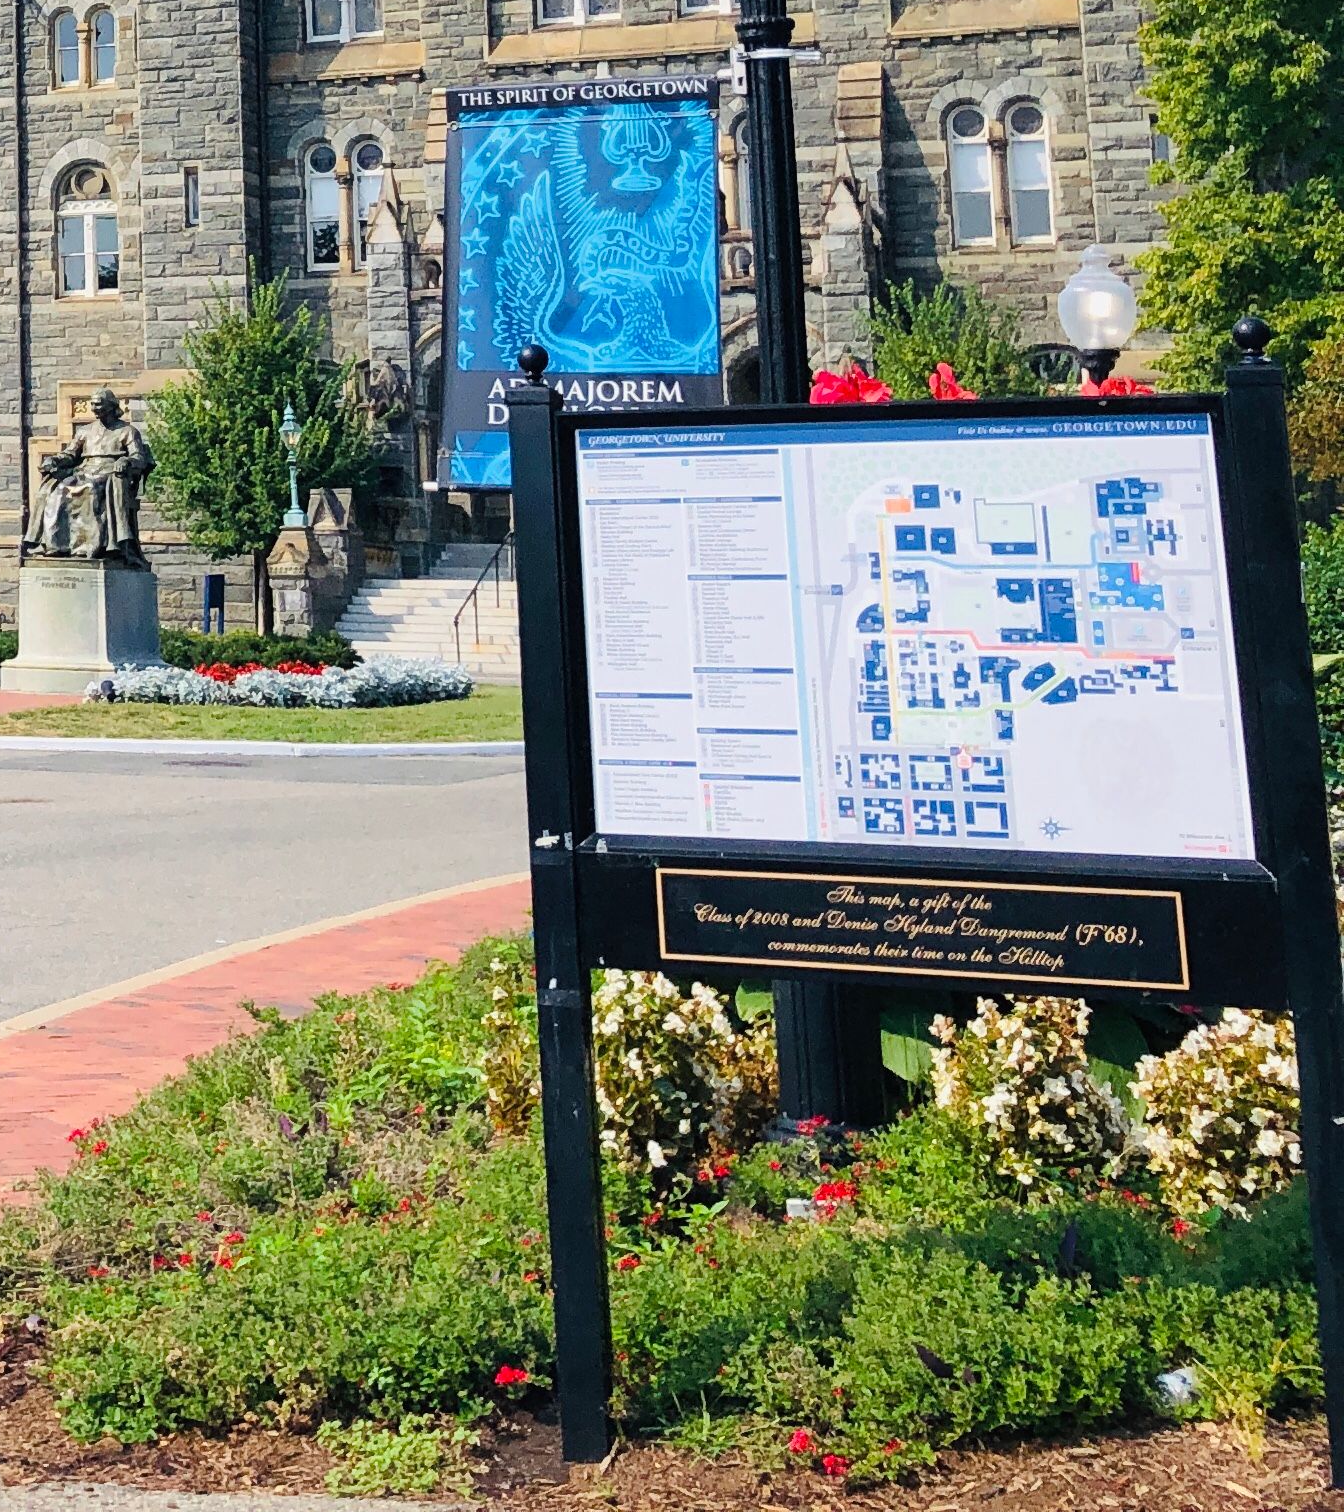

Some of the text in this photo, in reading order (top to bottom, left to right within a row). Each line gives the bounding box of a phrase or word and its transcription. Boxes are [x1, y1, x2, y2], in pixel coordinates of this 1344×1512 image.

[458, 79, 709, 107] THE SPIRIT OF GEORGETOWN
[588, 432, 726, 447] GEORGETOWN UNIVERSITY
[1052, 418, 1197, 433] GEORGETOWN.EDU
[826, 885, 992, 914] This map, a gift of the
[693, 903, 732, 923] Class
[735, 908, 753, 929] of
[752, 912, 788, 926] 2008
[792, 912, 824, 928] and
[825, 909, 878, 931] Denise
[883, 914, 959, 940] Hyland
[958, 916, 1070, 945] Dangremond
[768, 941, 1065, 972] commemorates their time on the Hilltop
